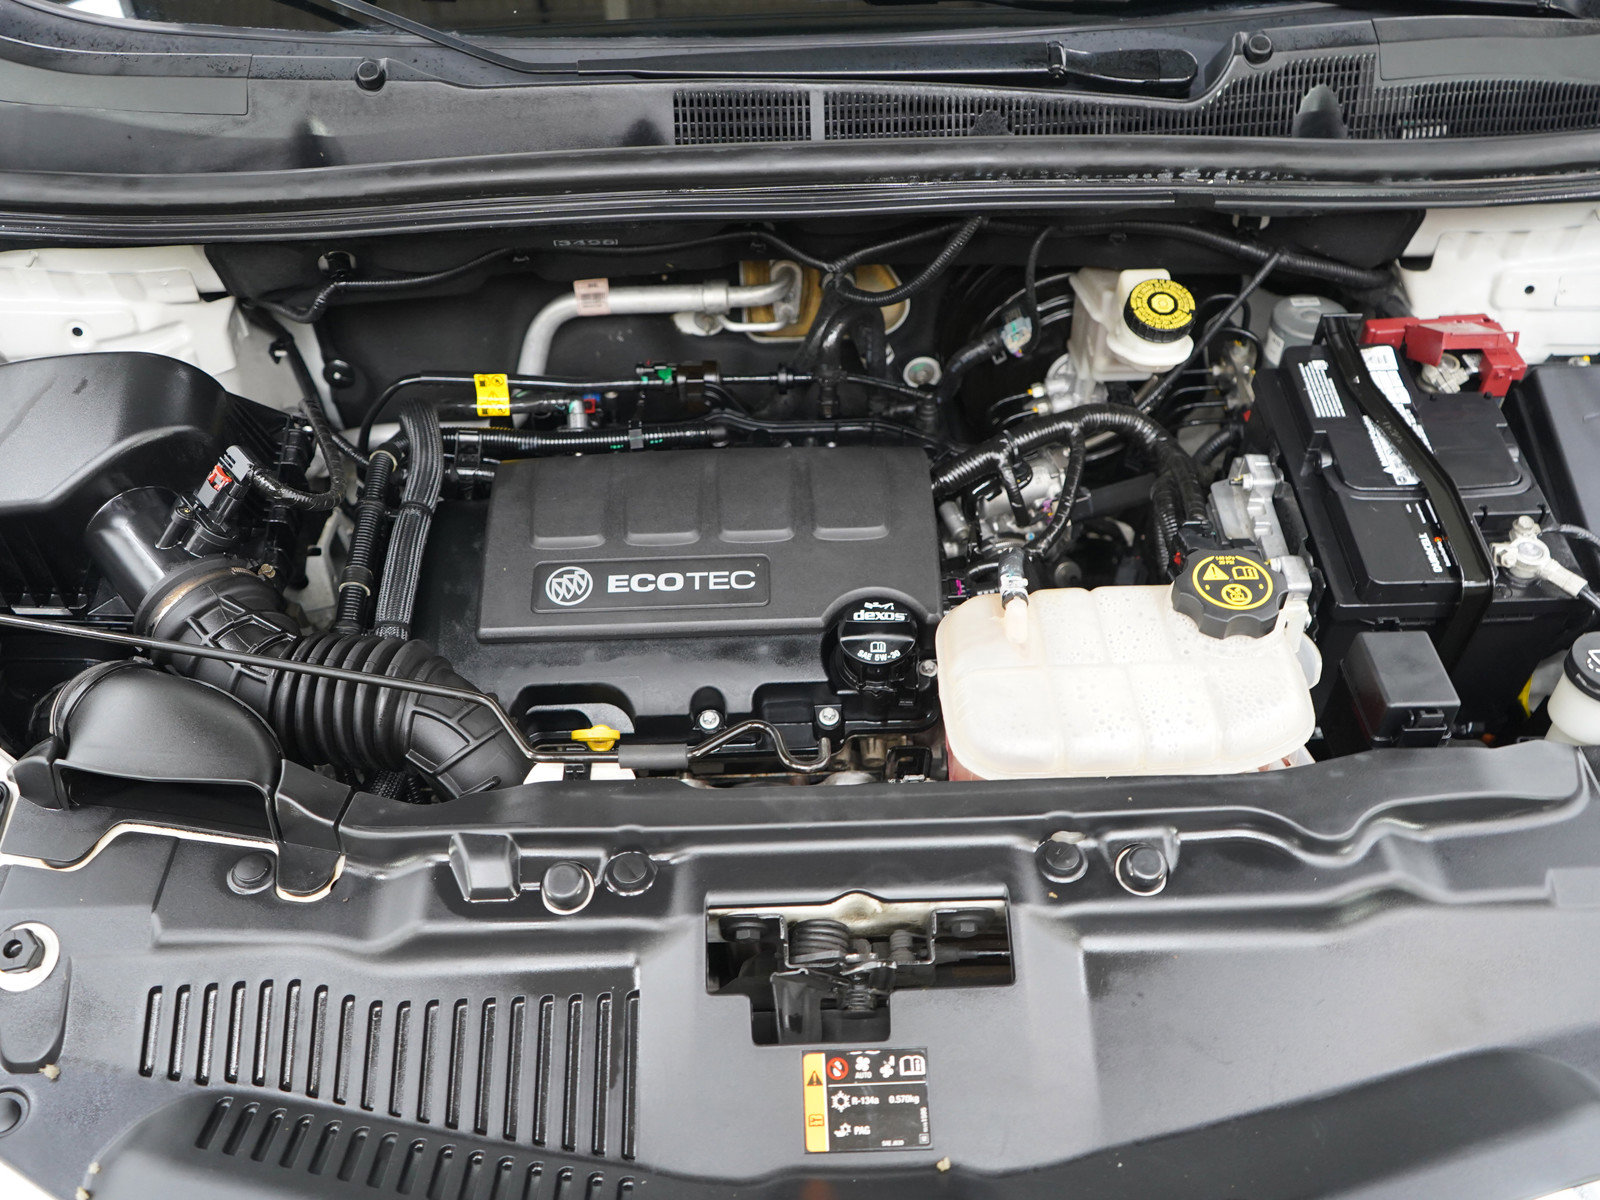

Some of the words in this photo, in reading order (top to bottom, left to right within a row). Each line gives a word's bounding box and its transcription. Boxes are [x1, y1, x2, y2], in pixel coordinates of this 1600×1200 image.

[607, 570, 756, 593] ECOTEC
[853, 609, 906, 621] dexos
[857, 649, 873, 661] SAE
[874, 649, 901, 661] 5W-30
[851, 1095, 880, 1105] R-134a
[853, 1125, 871, 1136] PAG
